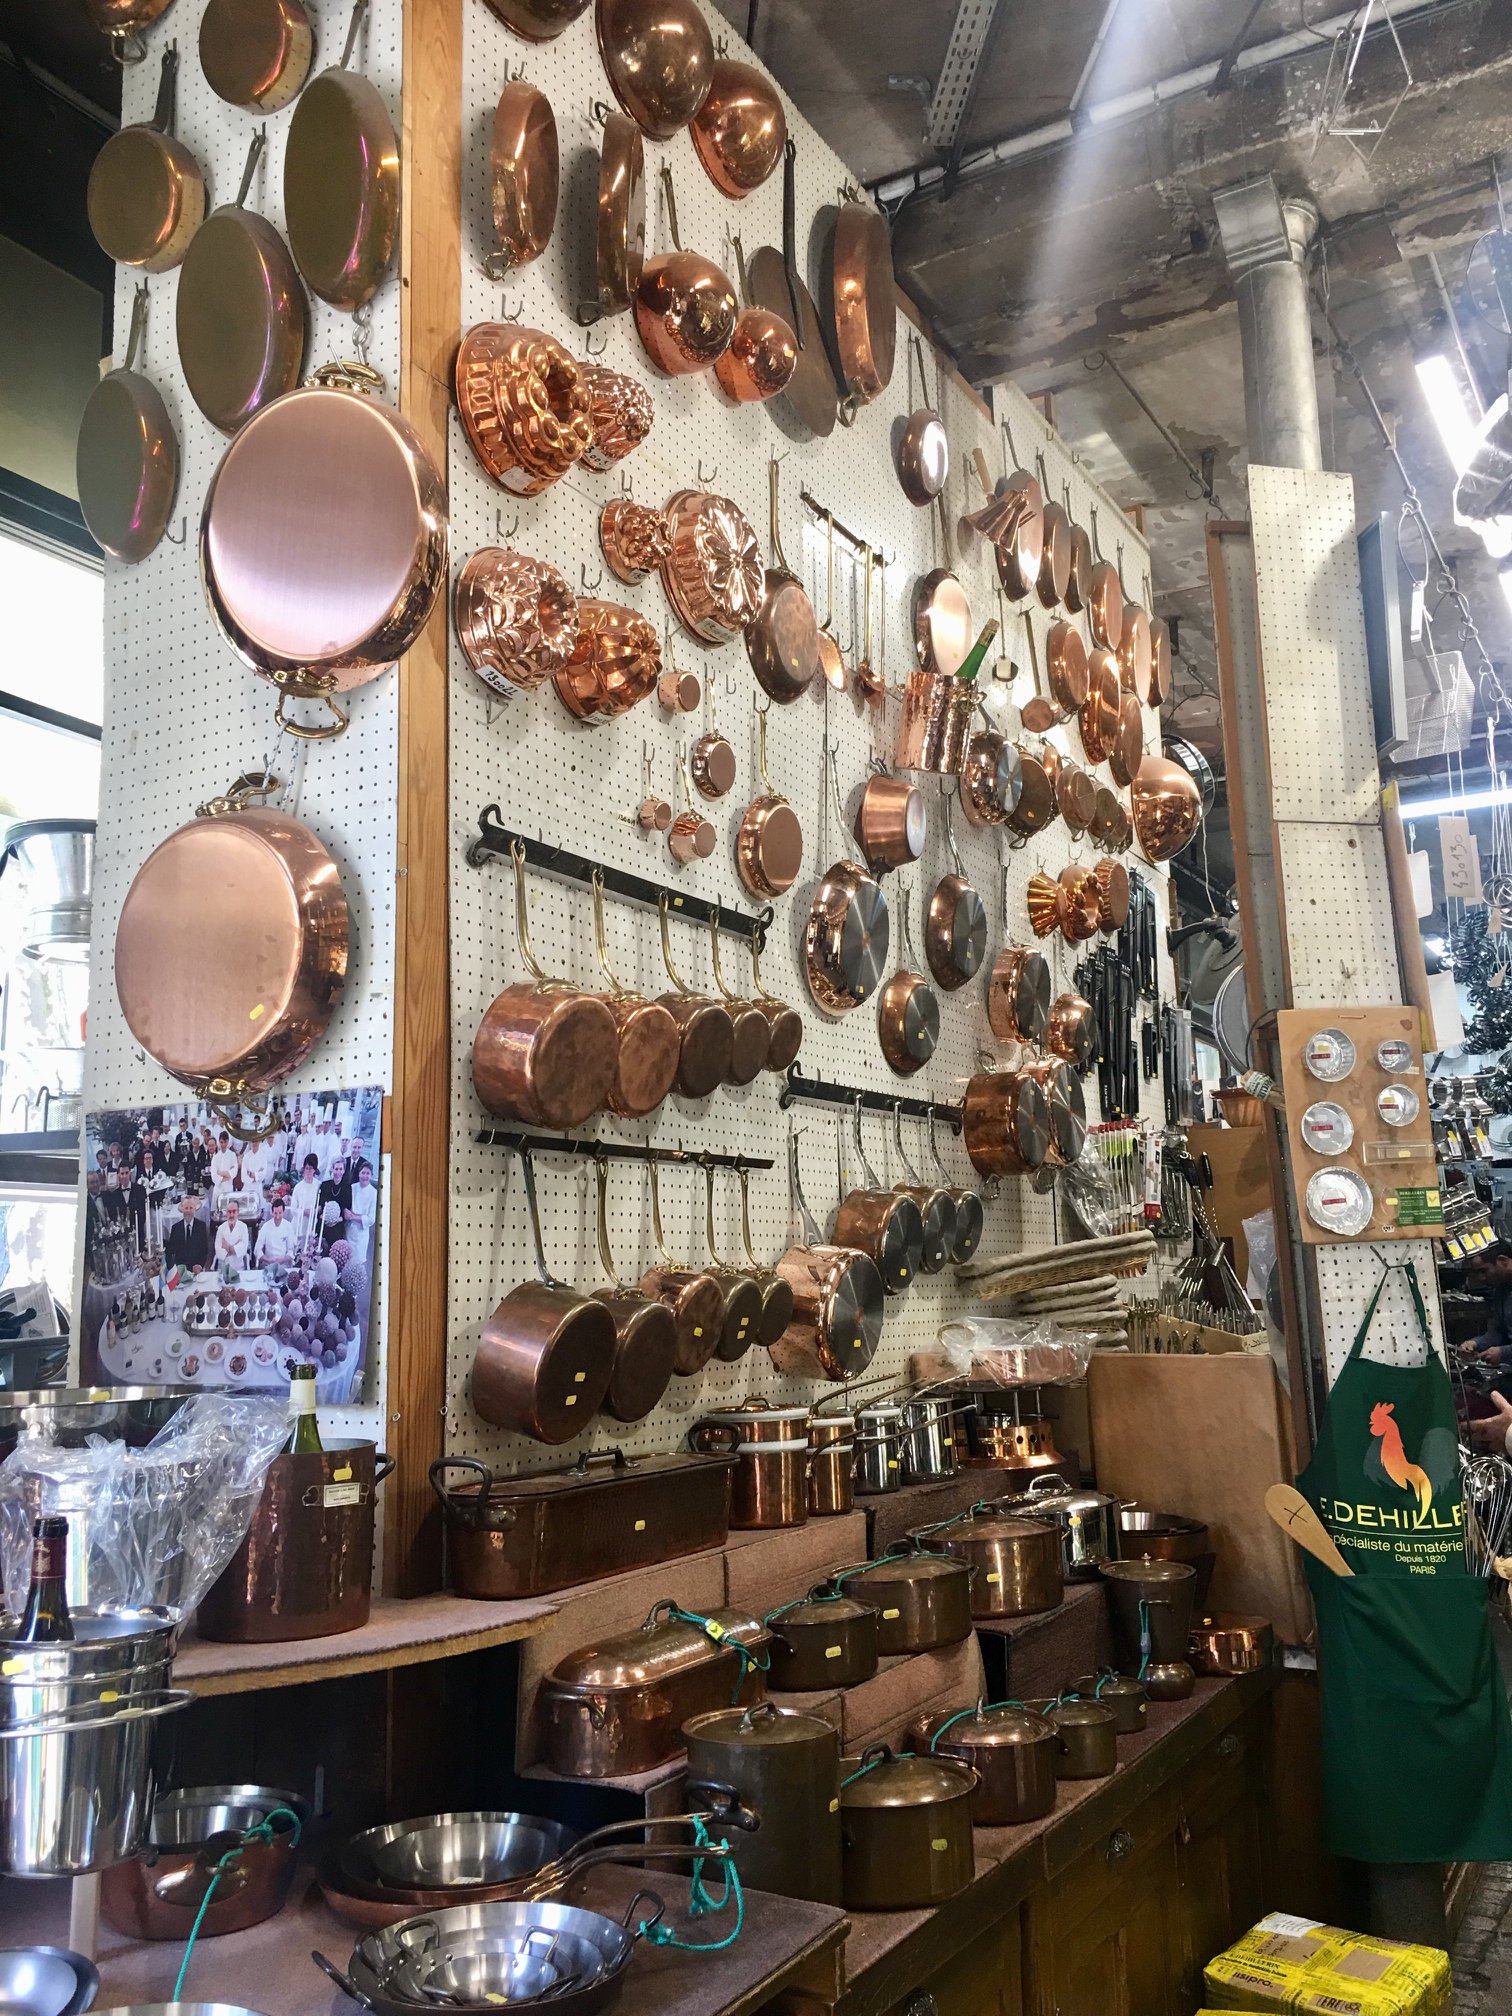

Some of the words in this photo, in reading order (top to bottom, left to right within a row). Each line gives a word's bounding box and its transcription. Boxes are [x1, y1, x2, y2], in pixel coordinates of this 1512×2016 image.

[1331, 1534, 1391, 1551] pécialiste
[1394, 1540, 1411, 1552] du
[1414, 1540, 1464, 1553] matérie
[1395, 1554, 1423, 1563] Depuis
[1425, 1555, 1447, 1563] 1820
[1410, 1565, 1437, 1575] PARIS
